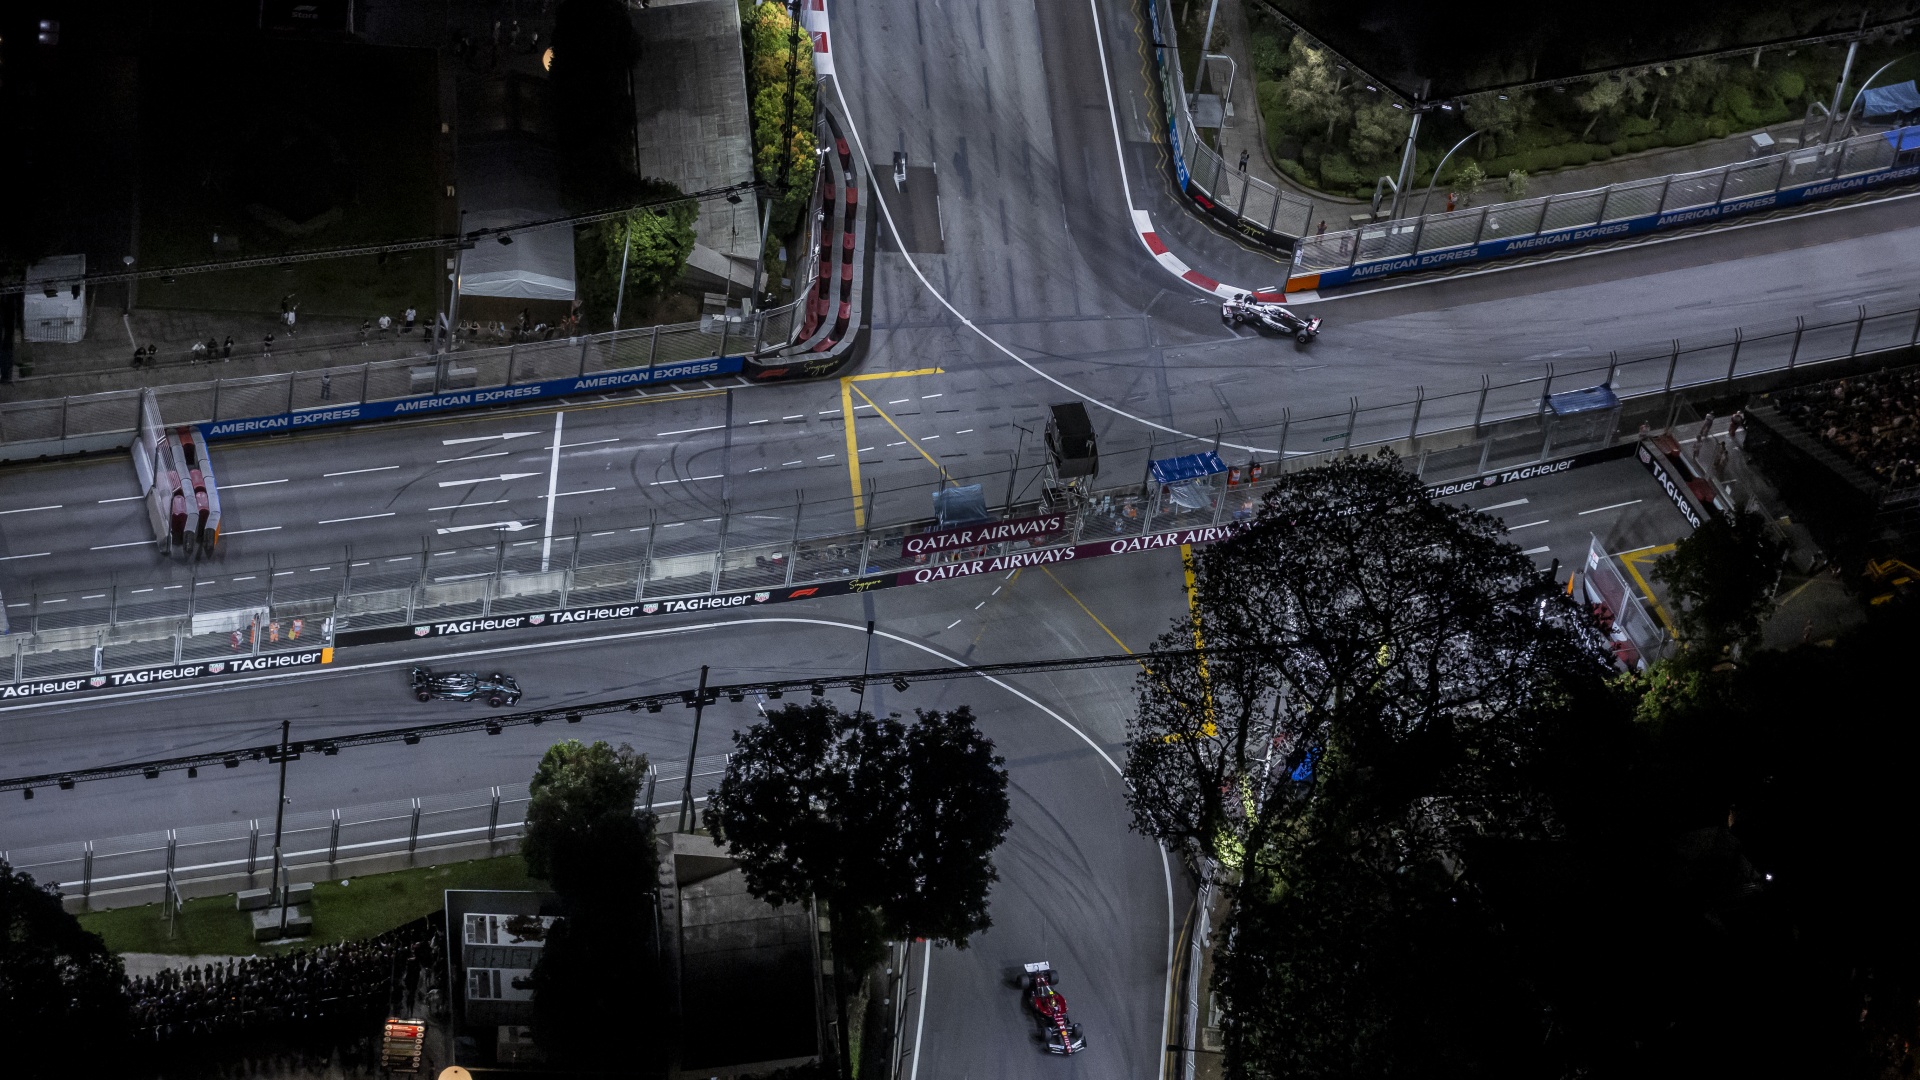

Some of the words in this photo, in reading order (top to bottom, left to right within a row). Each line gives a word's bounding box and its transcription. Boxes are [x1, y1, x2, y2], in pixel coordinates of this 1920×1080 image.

[1802, 178, 1863, 197] AMERICAN
[1865, 167, 1920, 184] EXPRESS
[1656, 206, 1720, 226] AMERICAN
[1722, 195, 1777, 213] EXPRESS
[1505, 233, 1571, 251] AMERICAN
[1573, 223, 1630, 240] EXPRESS
[1351, 258, 1418, 278] AMERICAN
[1421, 248, 1479, 266] EXPRESS
[574, 371, 649, 390] AMERICAN
[653, 362, 718, 379] EXPRESS
[394, 394, 471, 413] AMERICAN
[475, 386, 541, 403] EXPRESS
[210, 417, 288, 435] AMERICAN
[292, 408, 361, 425] EXPRESS
[1652, 461, 1701, 530] TAGHeue
[907, 530, 972, 554] QATAR
[977, 516, 1061, 541] AIRWAYS
[1110, 533, 1178, 554] QATAR
[914, 560, 984, 583] QATAR
[989, 546, 1076, 572] AIRWAYS
